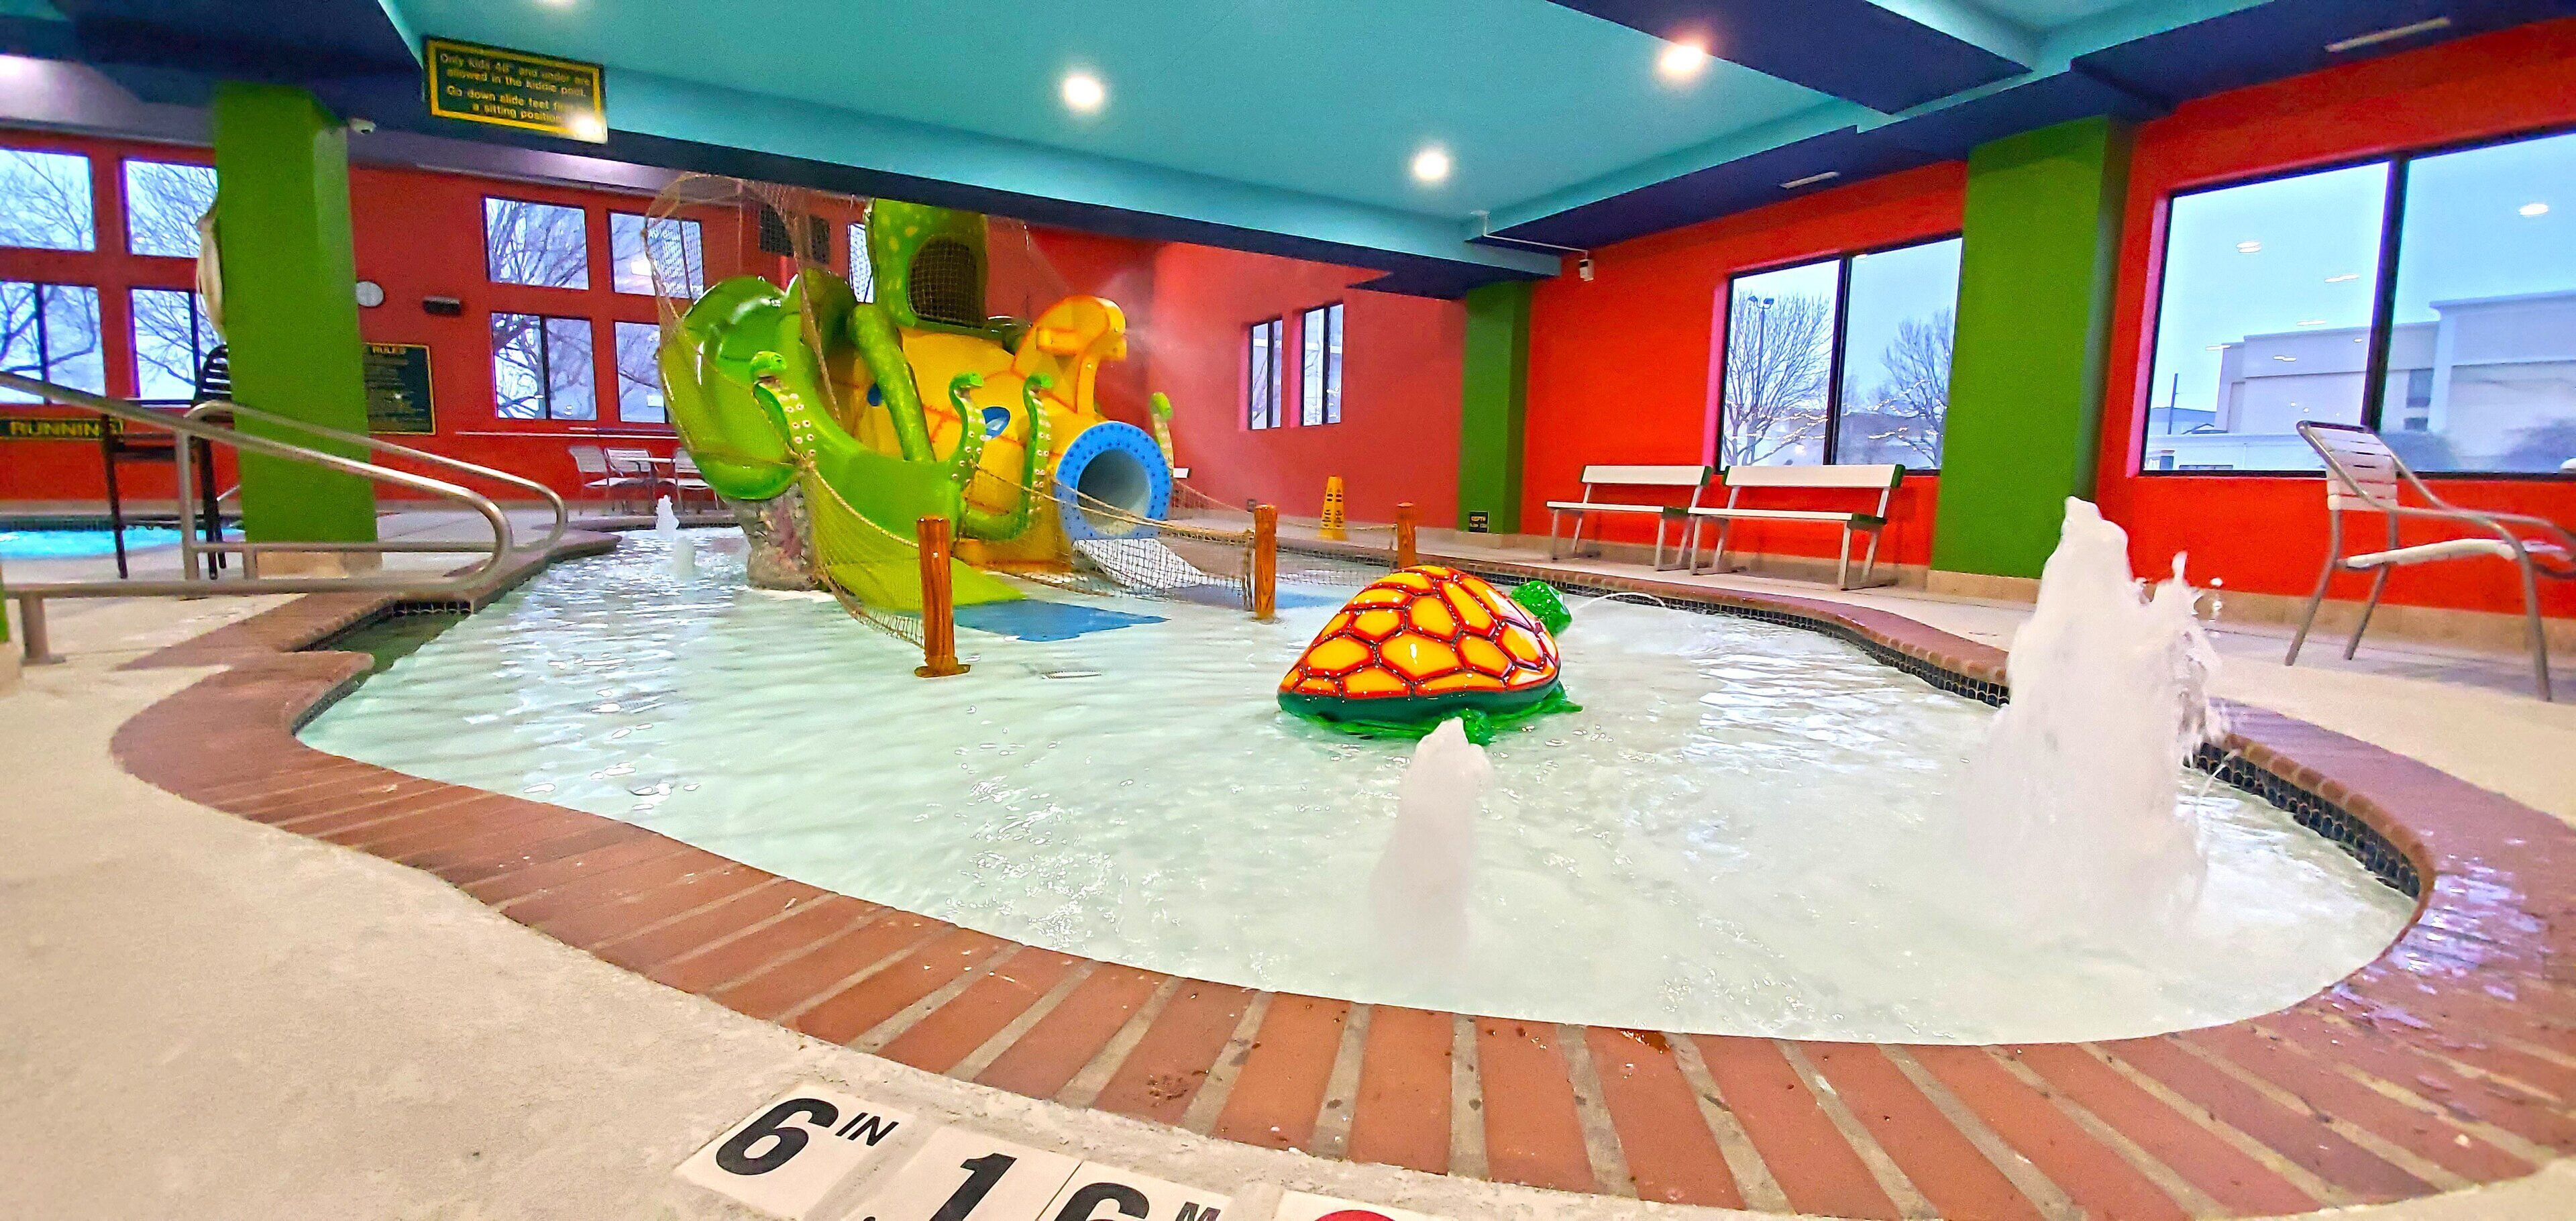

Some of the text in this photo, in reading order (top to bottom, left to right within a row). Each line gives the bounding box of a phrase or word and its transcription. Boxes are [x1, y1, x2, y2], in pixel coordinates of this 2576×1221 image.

[446, 68, 488, 81] allowed
[492, 75, 501, 84] in
[505, 75, 522, 87] the
[526, 80, 557, 93] kiddie
[519, 67, 537, 77] and
[446, 85, 463, 97] Go
[467, 88, 496, 101] down
[500, 93, 525, 106] slide
[528, 97, 549, 110] feet
[472, 103, 480, 112] a
[484, 103, 517, 119] sitting
[716, 1098, 900, 1176] 6 IN
